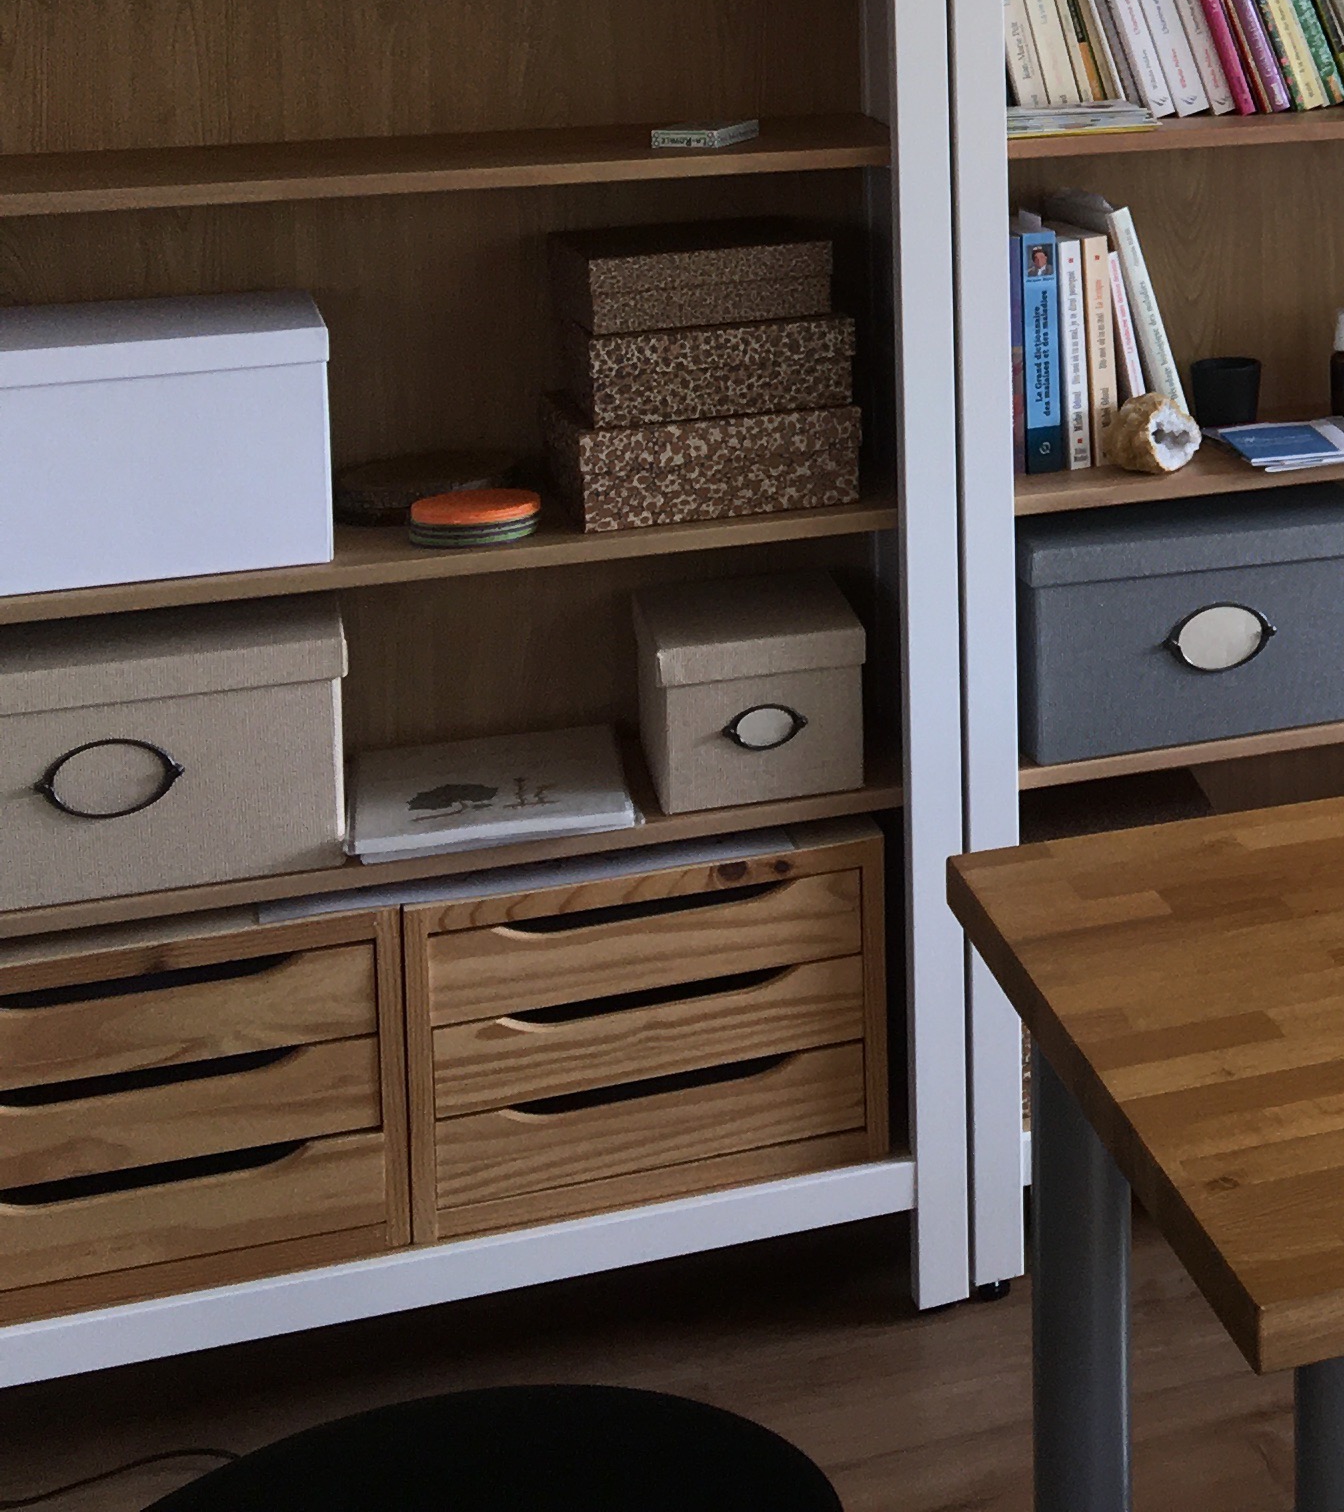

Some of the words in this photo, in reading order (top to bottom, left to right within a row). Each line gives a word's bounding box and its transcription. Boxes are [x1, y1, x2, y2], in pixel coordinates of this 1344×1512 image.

[1039, 290, 1048, 329] maladies
[1032, 305, 1043, 360] dictionnaire
[1040, 331, 1049, 347] des
[1042, 348, 1049, 358] et
[1033, 362, 1043, 389] Grand
[1042, 360, 1050, 399] malaises
[1034, 390, 1044, 402] Le
[1042, 400, 1051, 416] des
